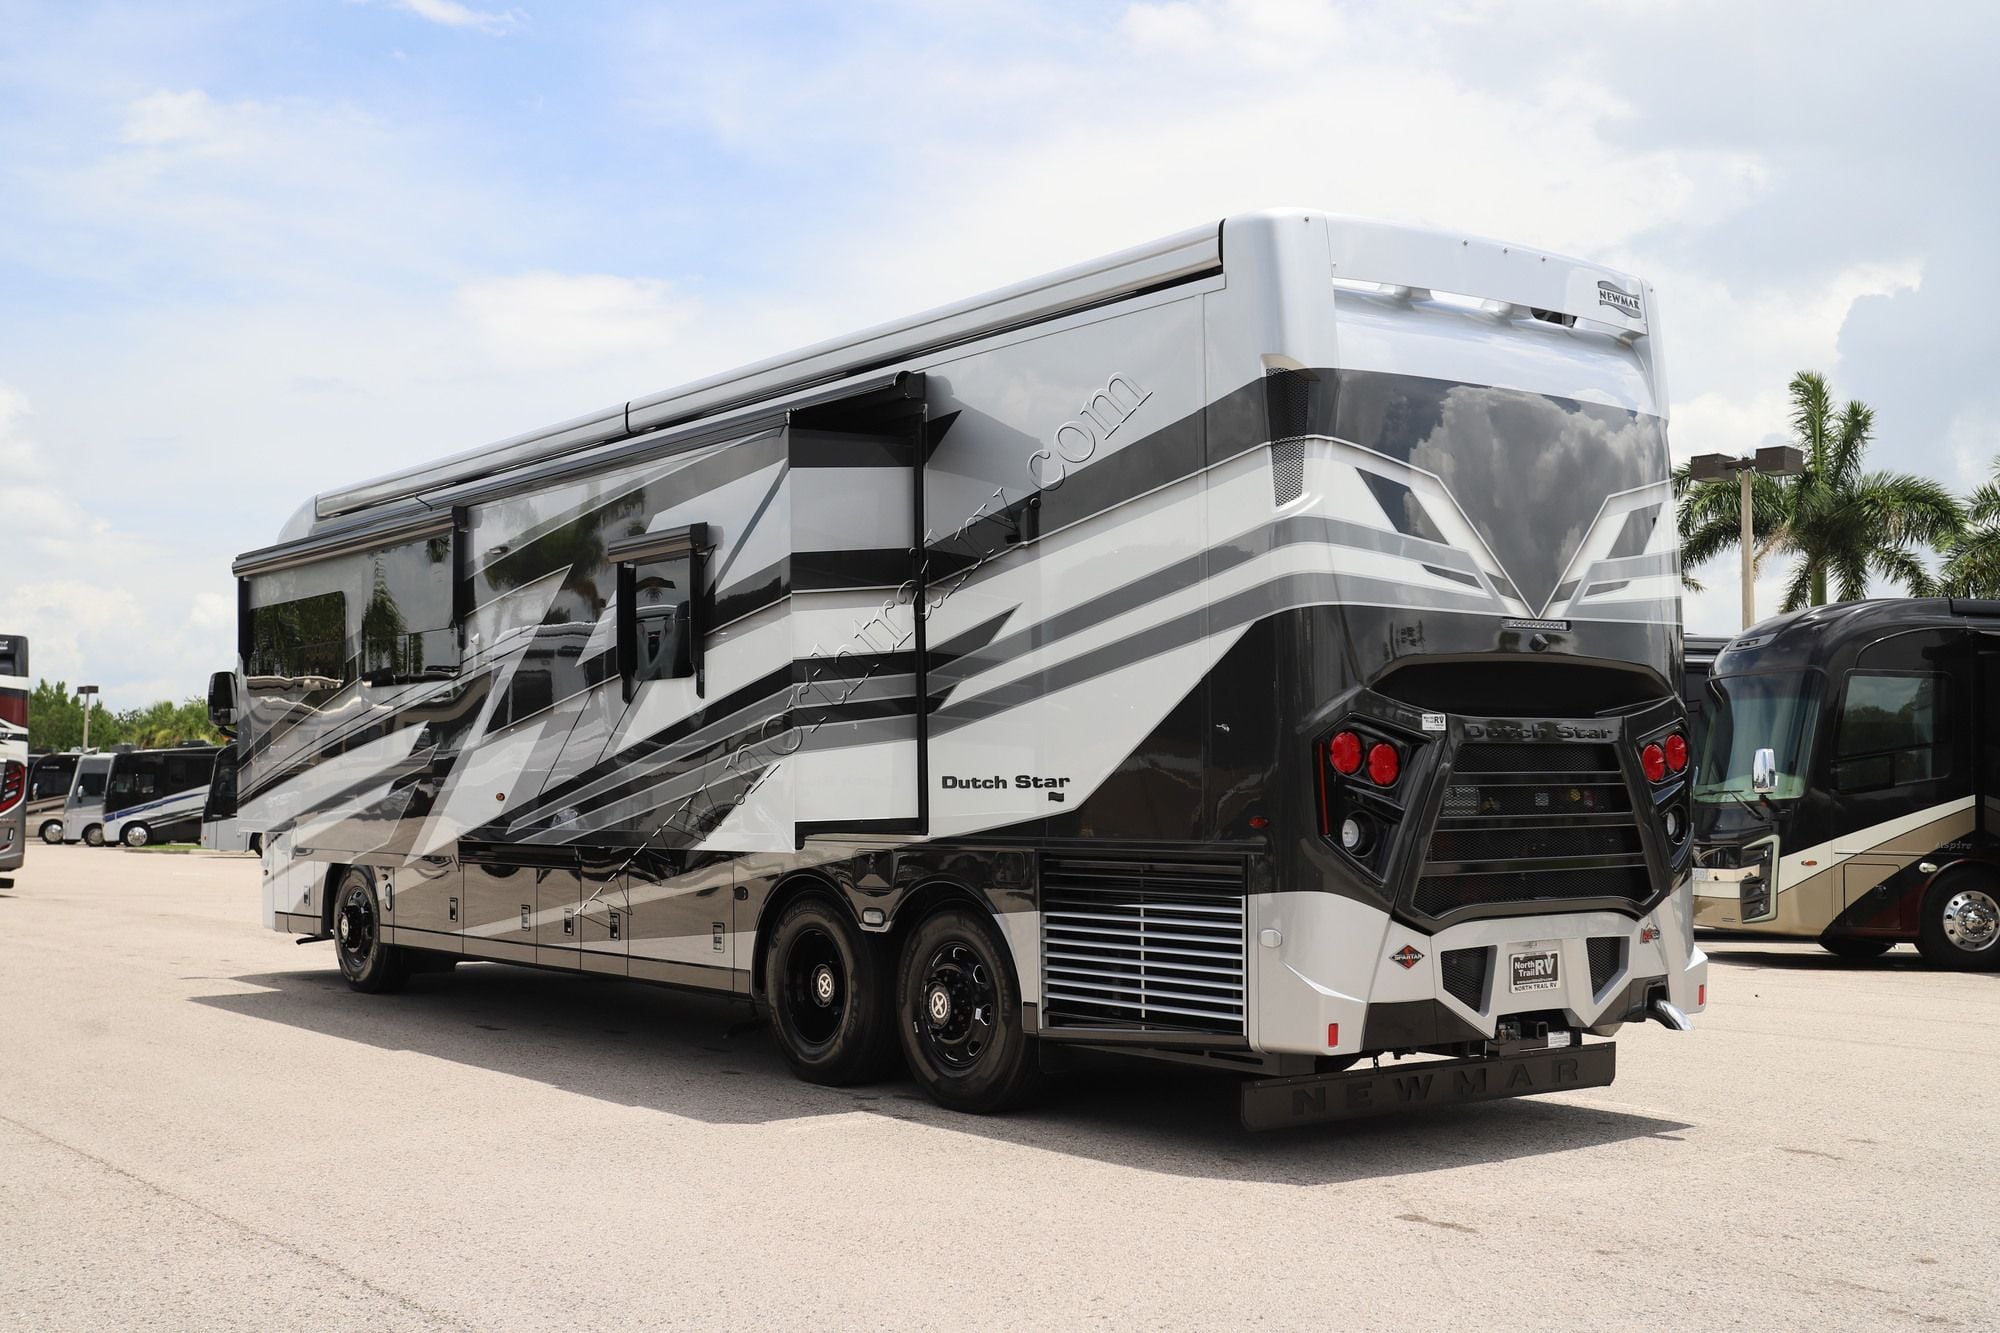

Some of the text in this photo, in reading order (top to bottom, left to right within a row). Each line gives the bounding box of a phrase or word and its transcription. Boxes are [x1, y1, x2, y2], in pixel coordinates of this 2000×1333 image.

[1599, 290, 1640, 310] NEWMAR
[1434, 716, 1444, 724] RV
[1463, 722, 1613, 739] Dutch Star
[941, 775, 1070, 789] Dutch Star
[1935, 840, 1973, 851] Aspire
[1394, 953, 1423, 961] SPARTAN
[1514, 960, 1535, 969] North
[1535, 958, 1554, 976] RV
[1518, 969, 1535, 977] Trail
[1514, 984, 1533, 992] NORTH
[1291, 1058, 1579, 1117] NEWMAR
